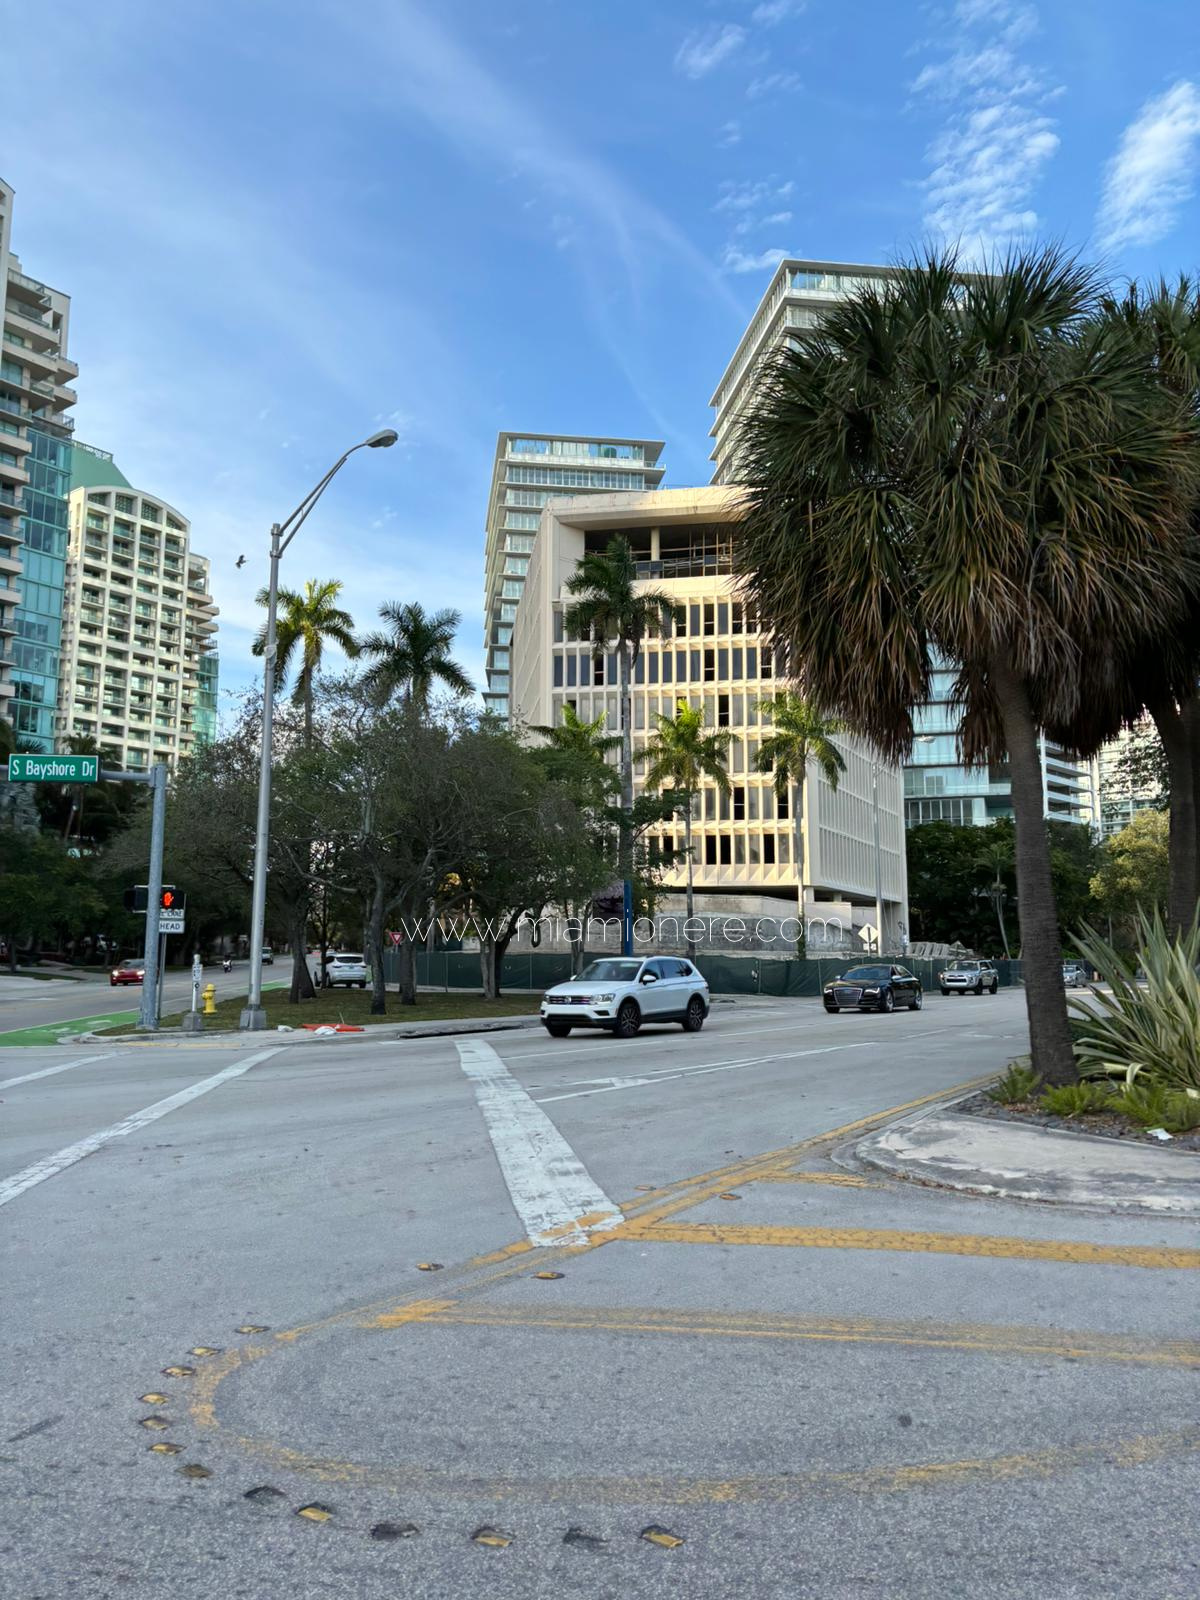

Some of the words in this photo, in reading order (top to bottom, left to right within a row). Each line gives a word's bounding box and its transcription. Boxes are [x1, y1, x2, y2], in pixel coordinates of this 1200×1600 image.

[12, 759, 20, 776] S
[26, 760, 76, 780] Bayshore
[82, 761, 94, 777] Dr
[160, 922, 180, 930] HEAD
